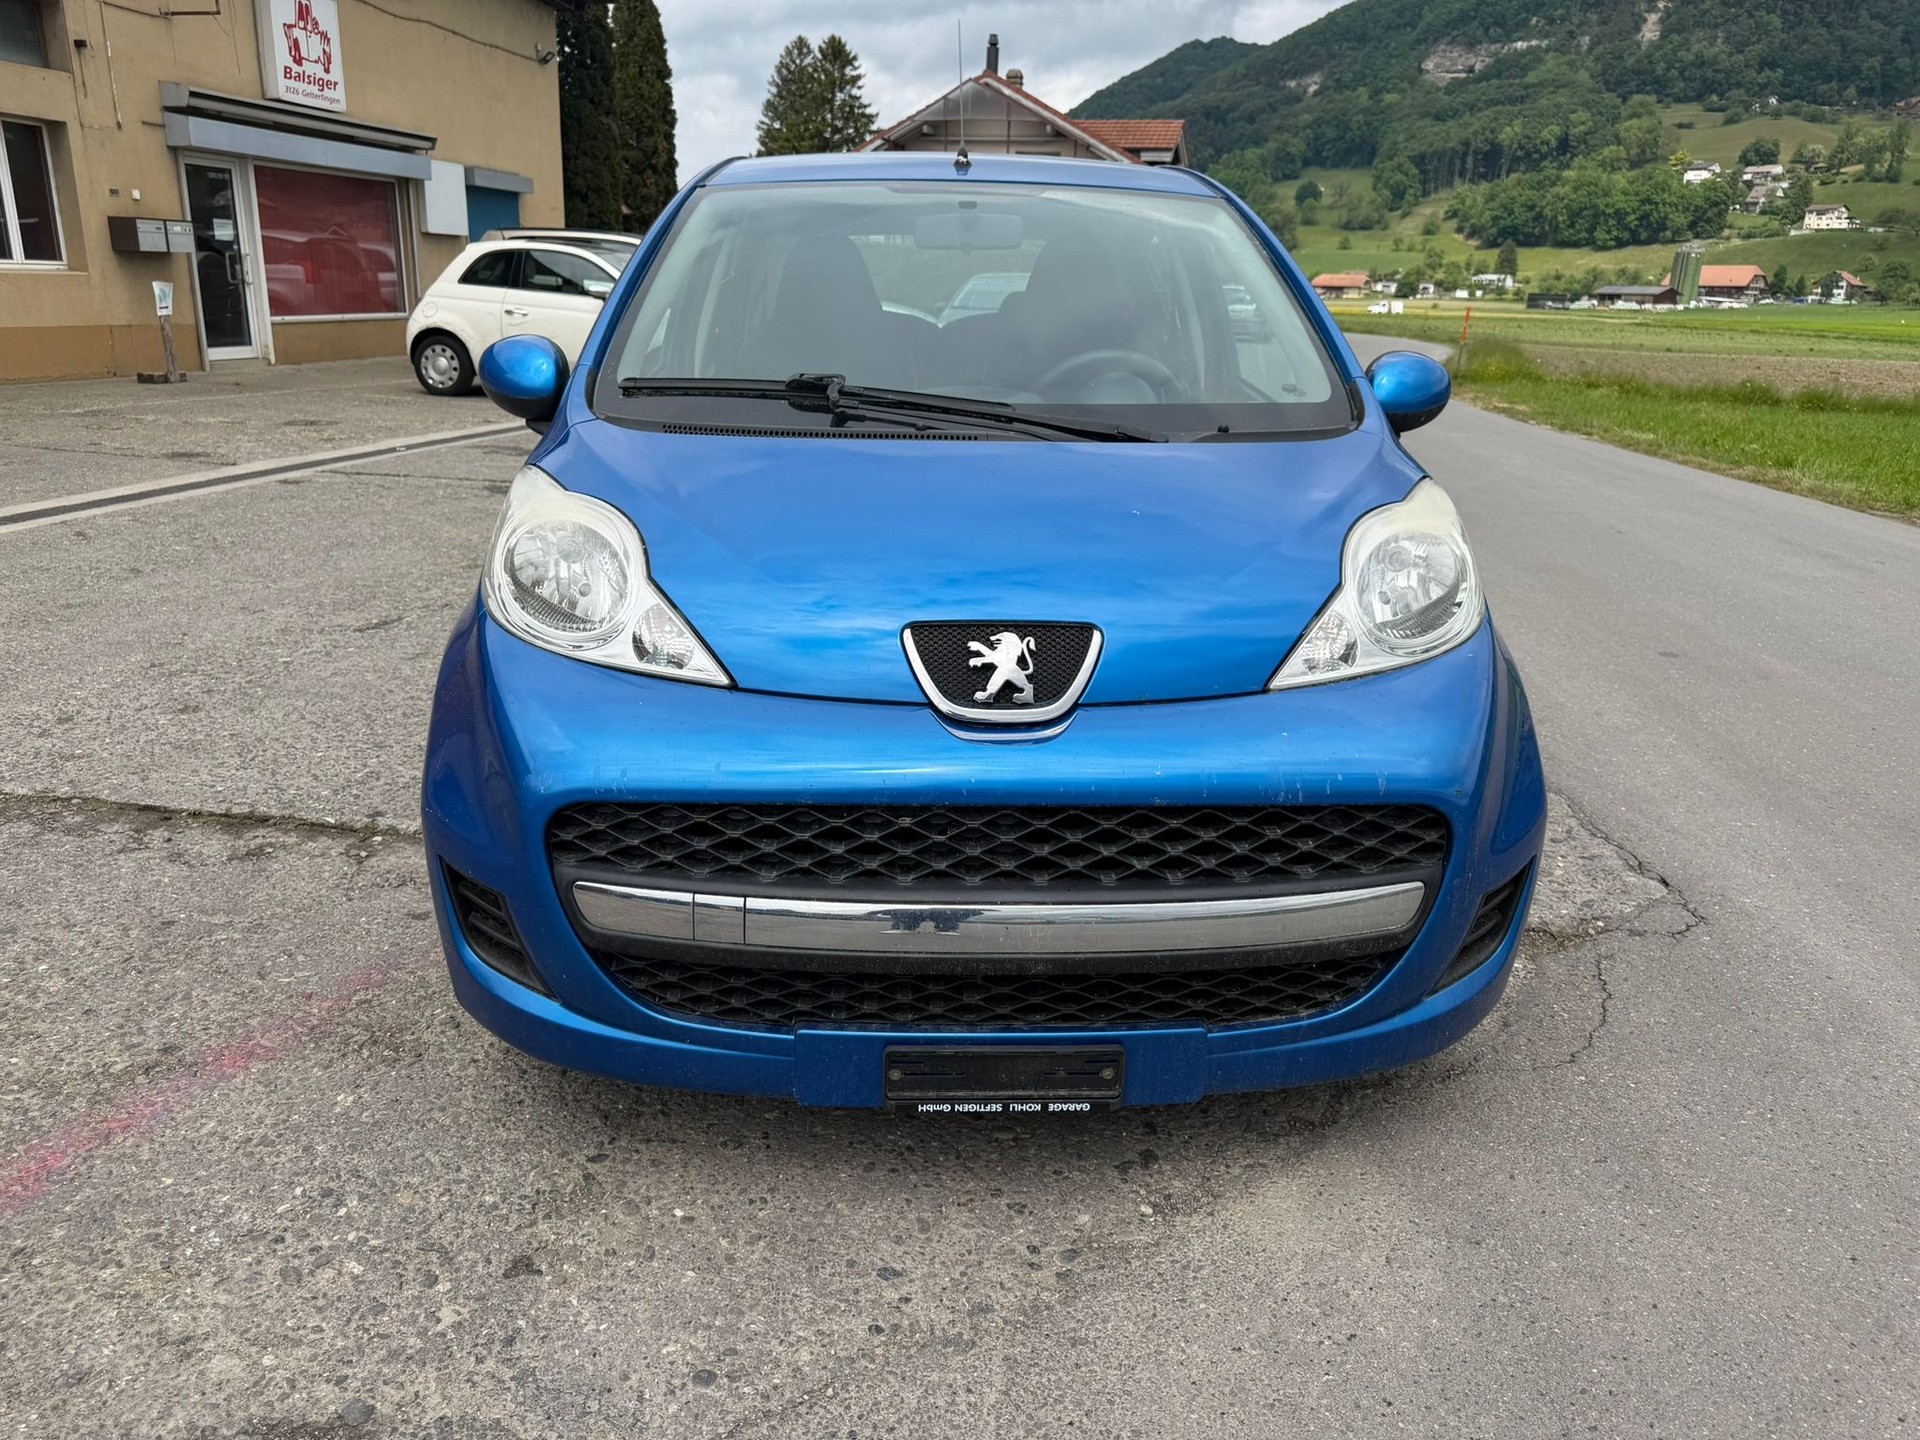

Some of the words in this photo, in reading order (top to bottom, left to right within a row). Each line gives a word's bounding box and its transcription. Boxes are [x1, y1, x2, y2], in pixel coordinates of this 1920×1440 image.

[284, 65, 338, 92] Balsiger
[285, 85, 299, 96] 3126
[301, 89, 341, 105] Gelterfingen
[918, 1104, 951, 1113] GmbH
[954, 1103, 1003, 1112] SEFTIGEN
[1009, 1103, 1041, 1112] KOHLI
[1048, 1103, 1091, 1111] GARAGE
